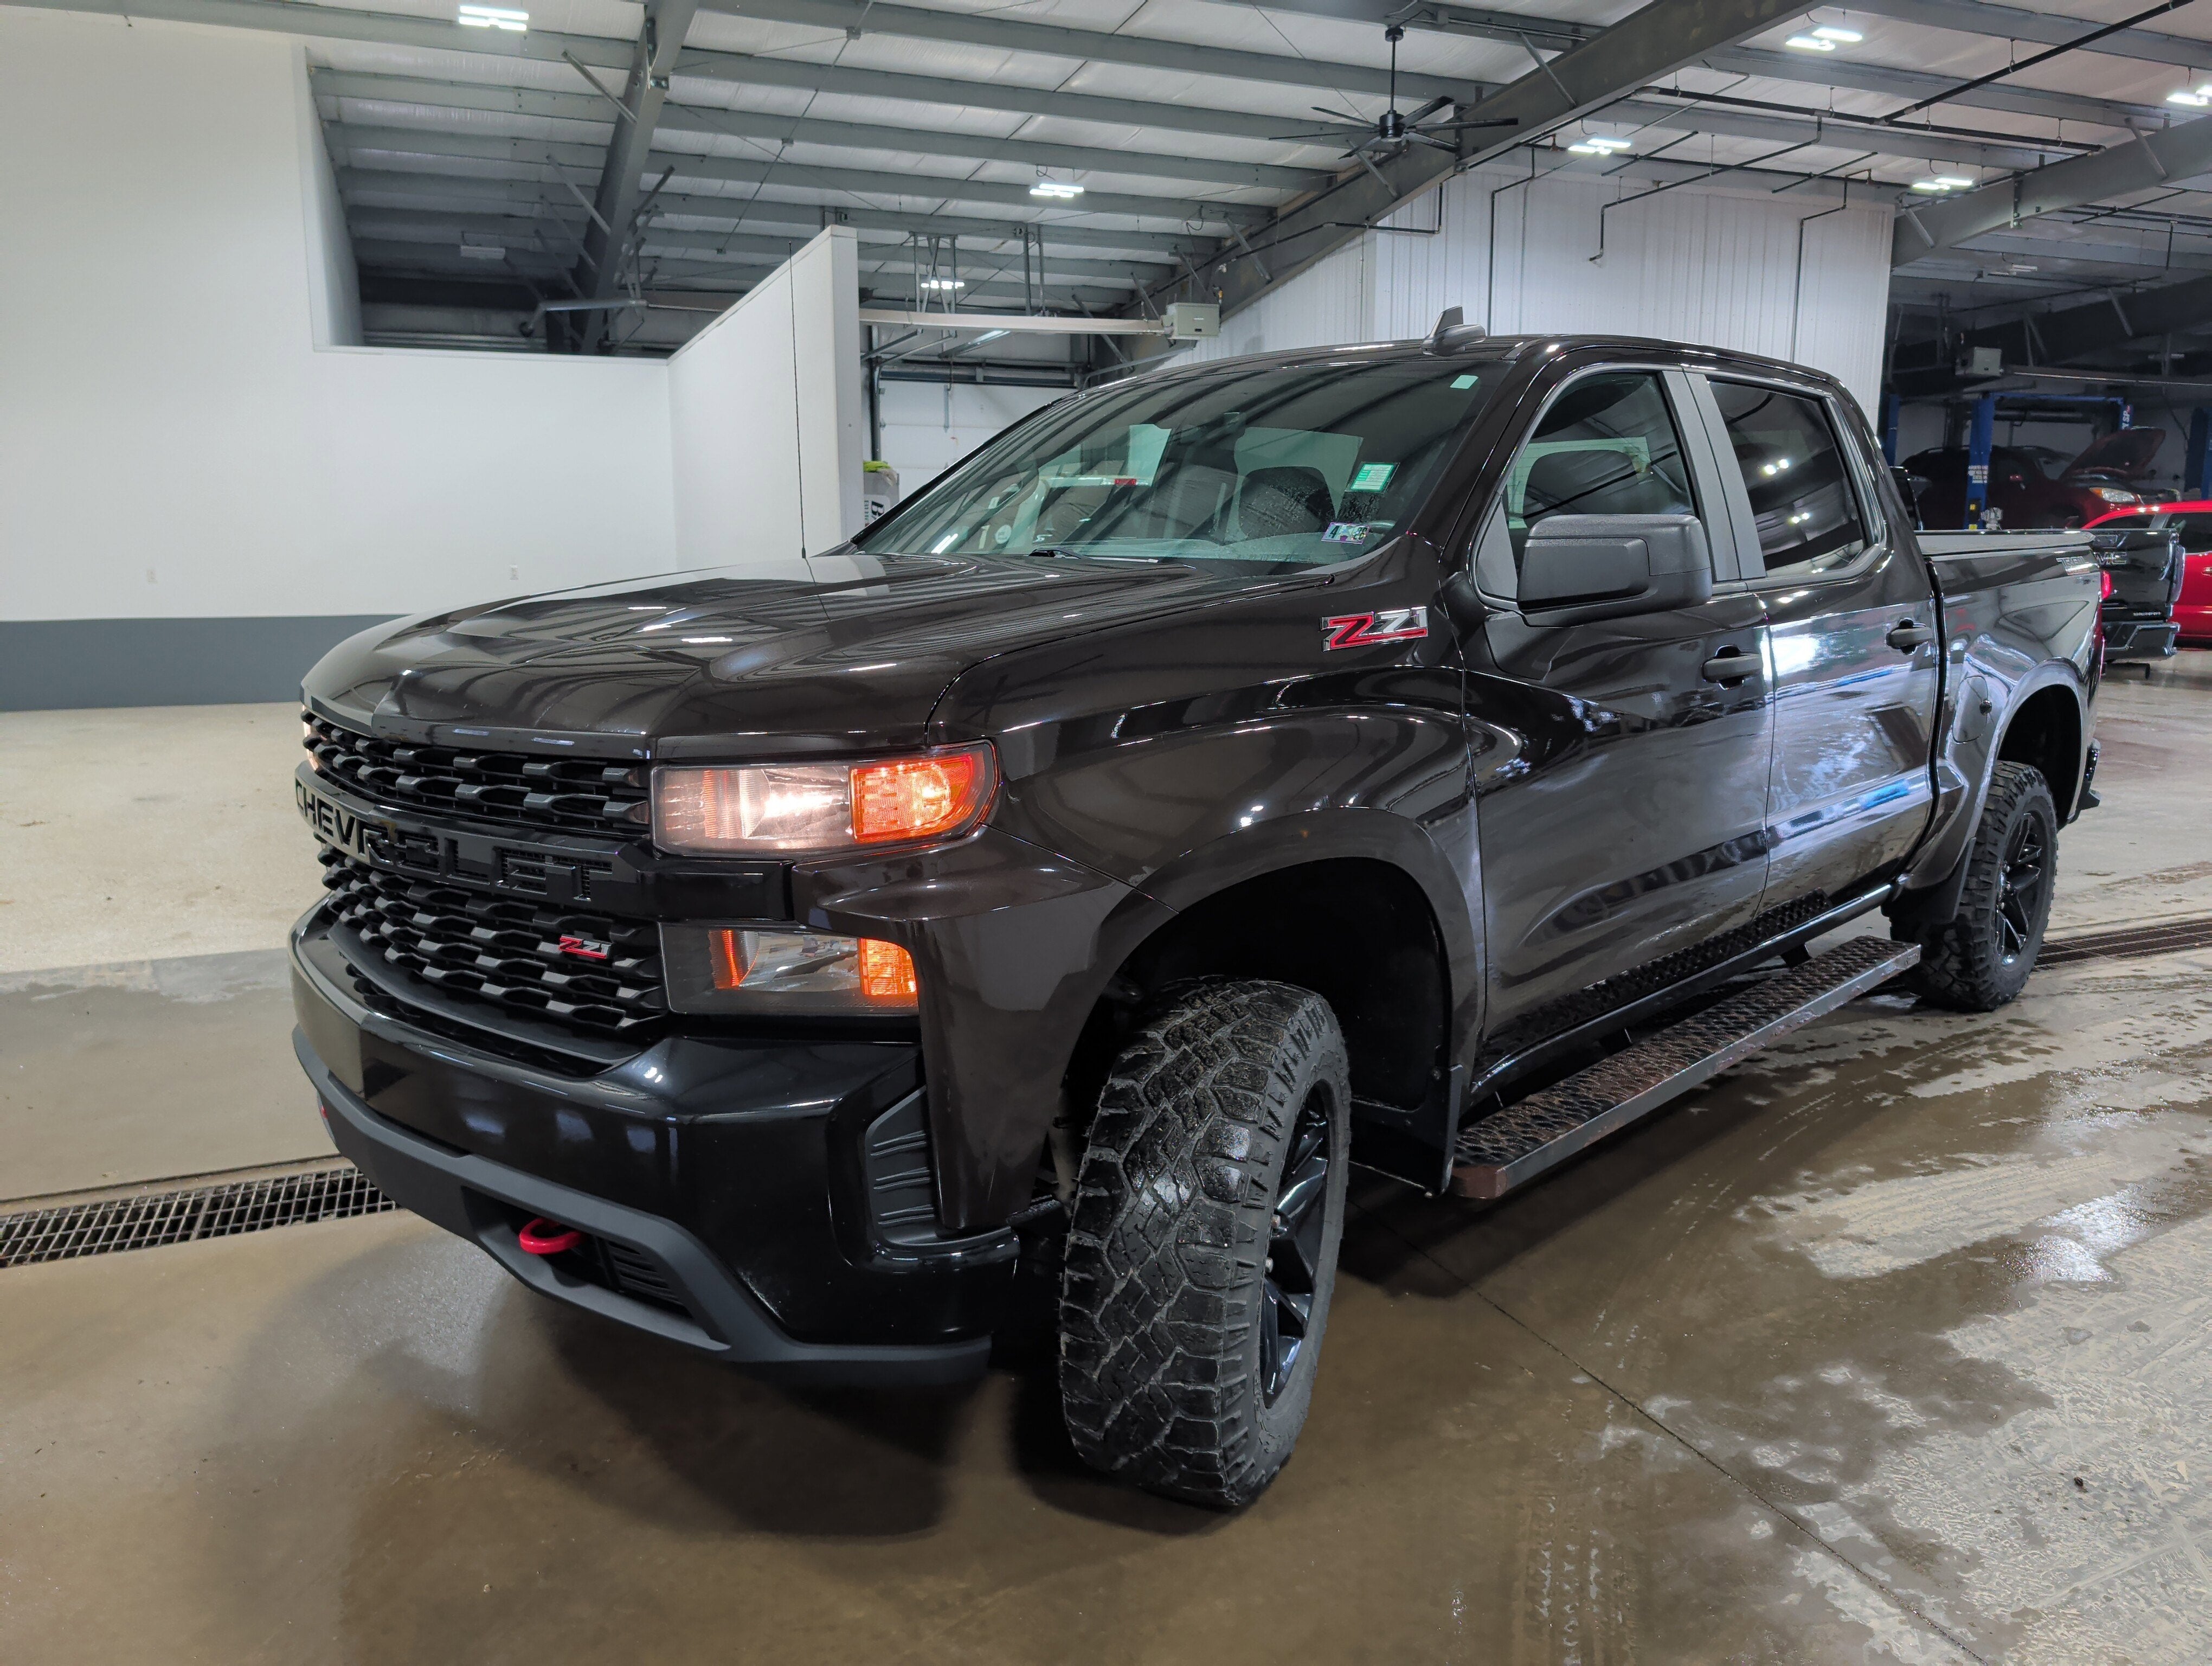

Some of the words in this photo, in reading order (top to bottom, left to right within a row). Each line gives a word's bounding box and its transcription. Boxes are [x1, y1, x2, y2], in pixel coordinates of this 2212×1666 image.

[1320, 605, 1429, 652] Z71
[295, 778, 613, 901] CHEVROLET
[559, 934, 612, 959] Z71
